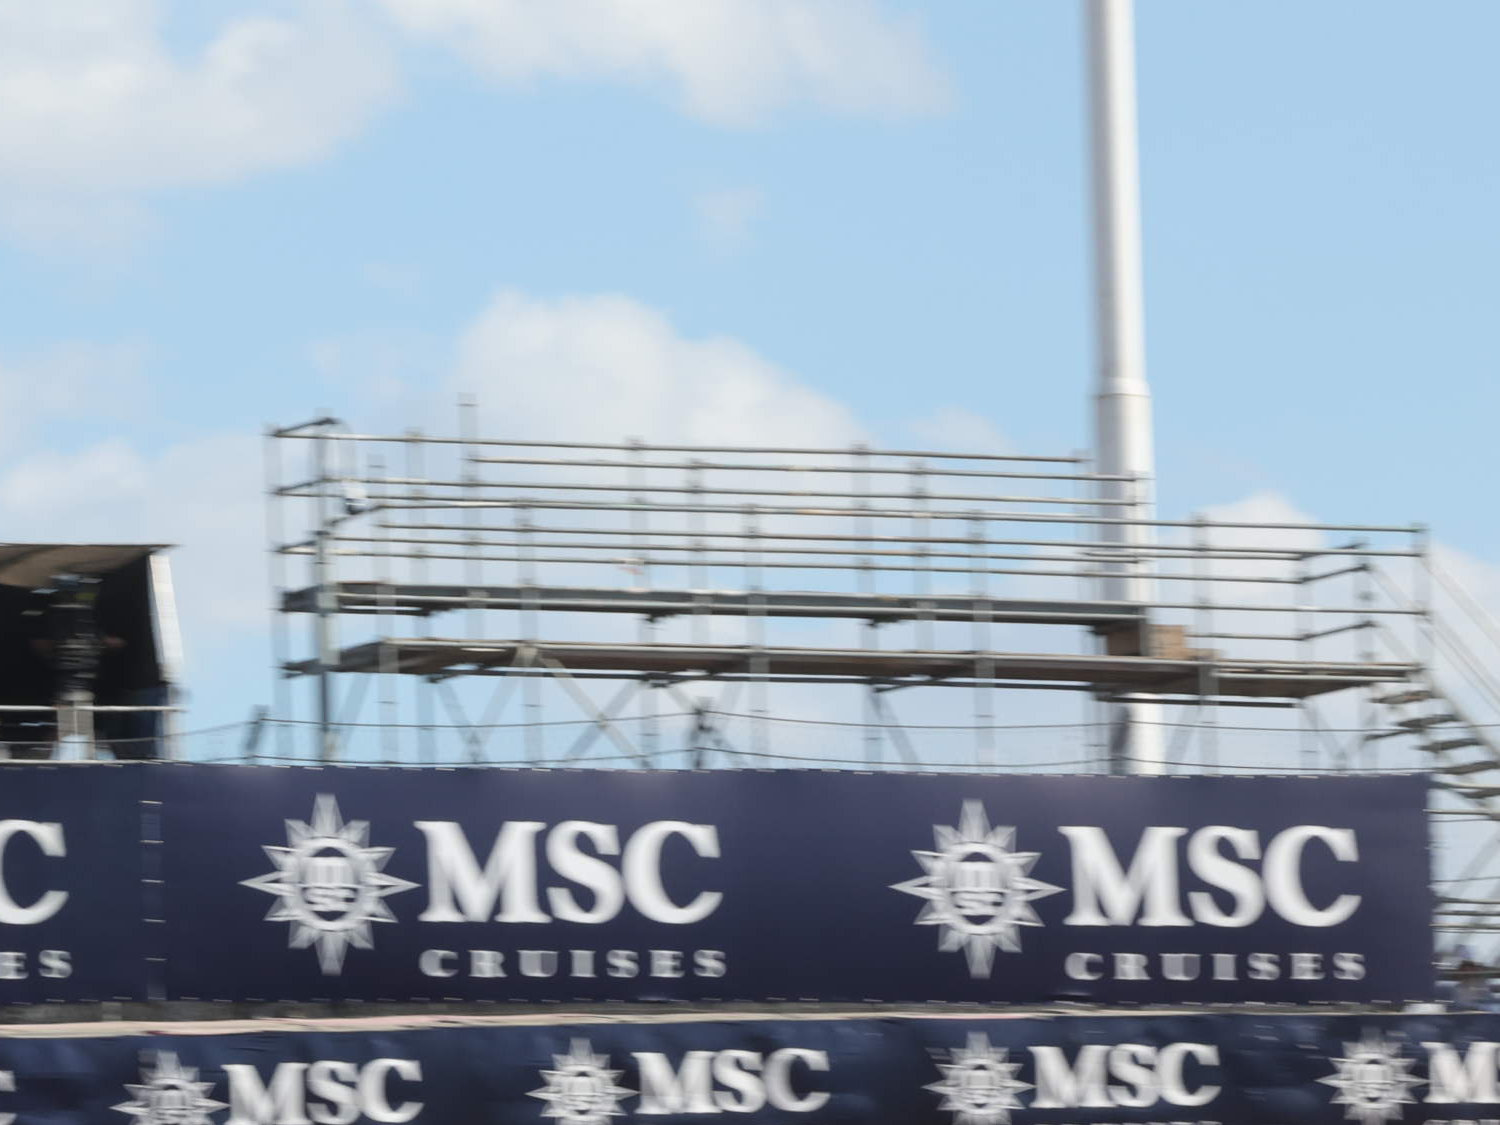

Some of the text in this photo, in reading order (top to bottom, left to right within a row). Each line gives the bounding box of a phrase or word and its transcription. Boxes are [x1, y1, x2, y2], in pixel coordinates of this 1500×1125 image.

[414, 820, 723, 924] MSC
[1057, 824, 1362, 928] MSC
[419, 949, 727, 978] CRUISES
[1064, 952, 1366, 981] CRUISES
[631, 1047, 831, 1115] MSC
[1027, 1043, 1222, 1109] MSC
